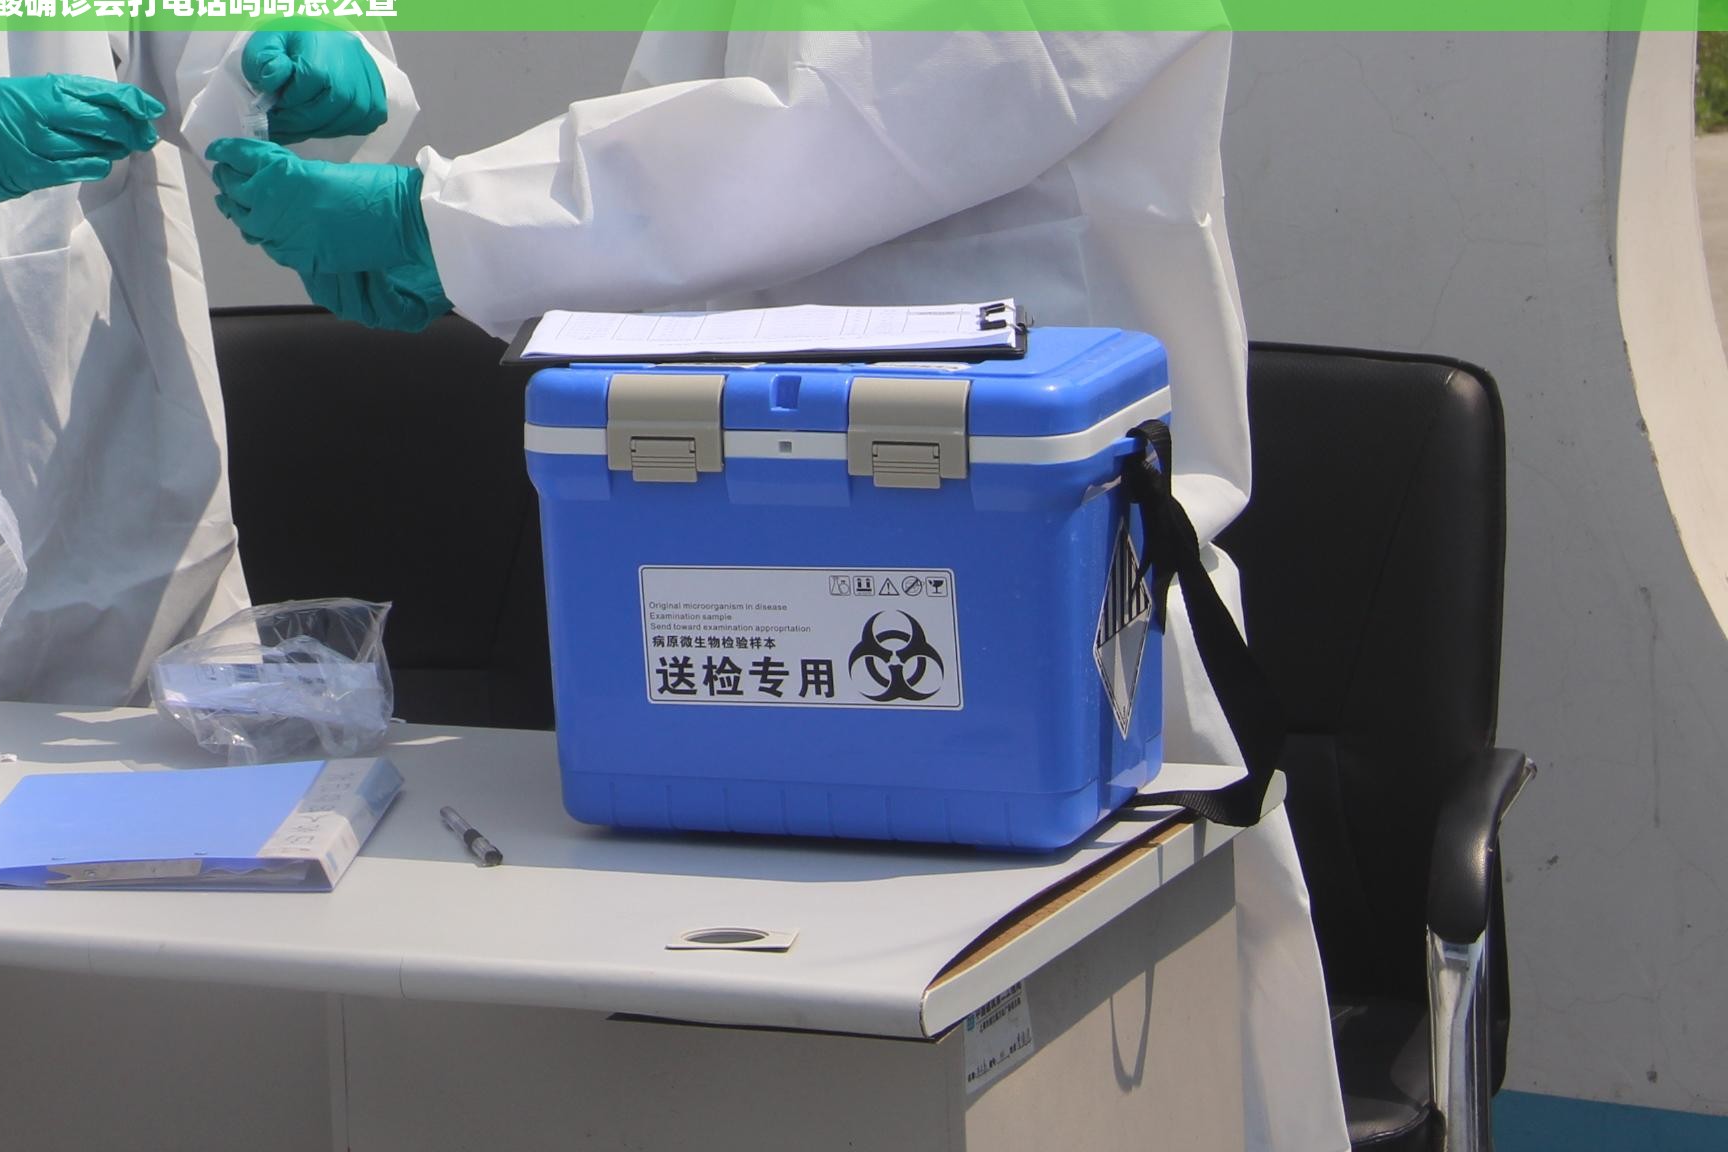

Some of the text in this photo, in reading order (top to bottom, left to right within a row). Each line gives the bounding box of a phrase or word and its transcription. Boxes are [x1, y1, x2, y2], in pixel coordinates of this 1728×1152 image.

[649, 602, 681, 611] Original
[650, 612, 700, 620] Examination
[652, 635, 776, 649] 病原微生物检验样本
[656, 655, 835, 698] 送检专用
